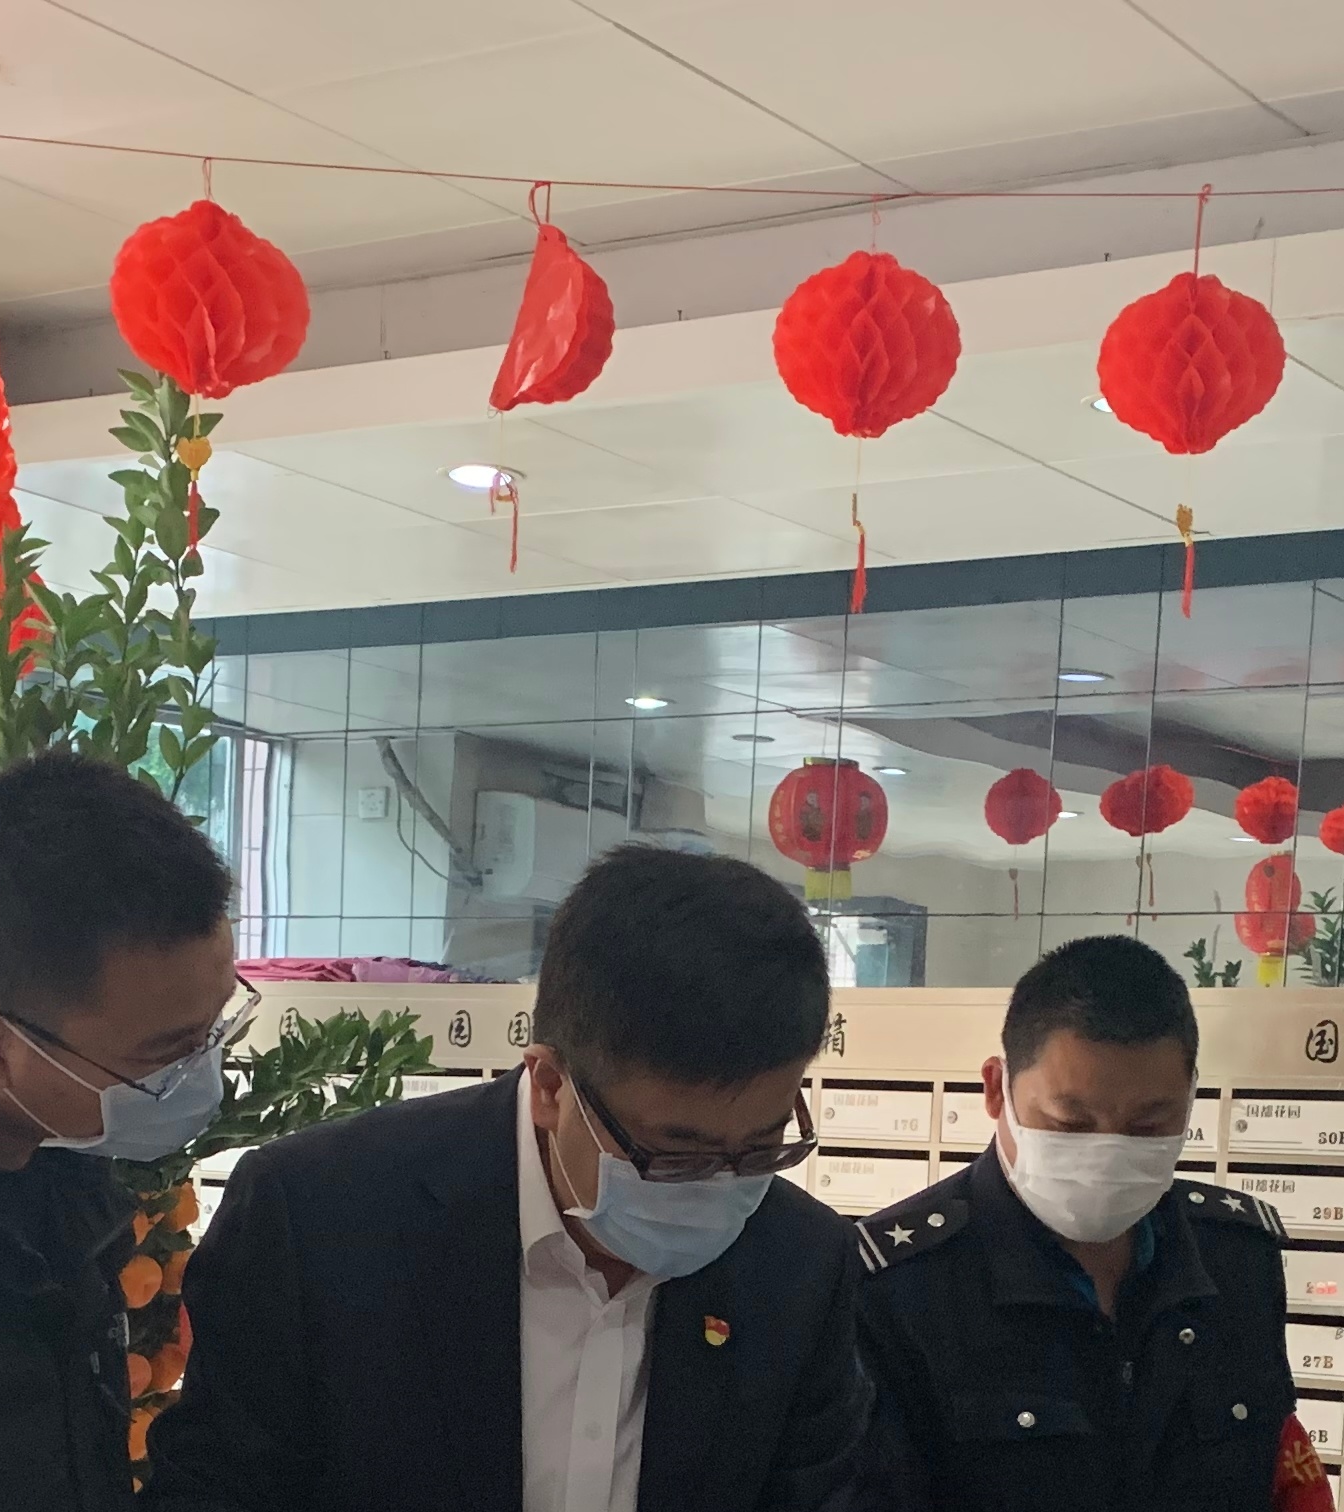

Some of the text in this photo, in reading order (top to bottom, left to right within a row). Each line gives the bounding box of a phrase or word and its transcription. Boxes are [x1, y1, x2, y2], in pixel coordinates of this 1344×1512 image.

[1312, 1206, 1344, 1221] 29B
[1302, 1355, 1335, 1370] 27B
[1308, 1429, 1329, 1444] 6B
